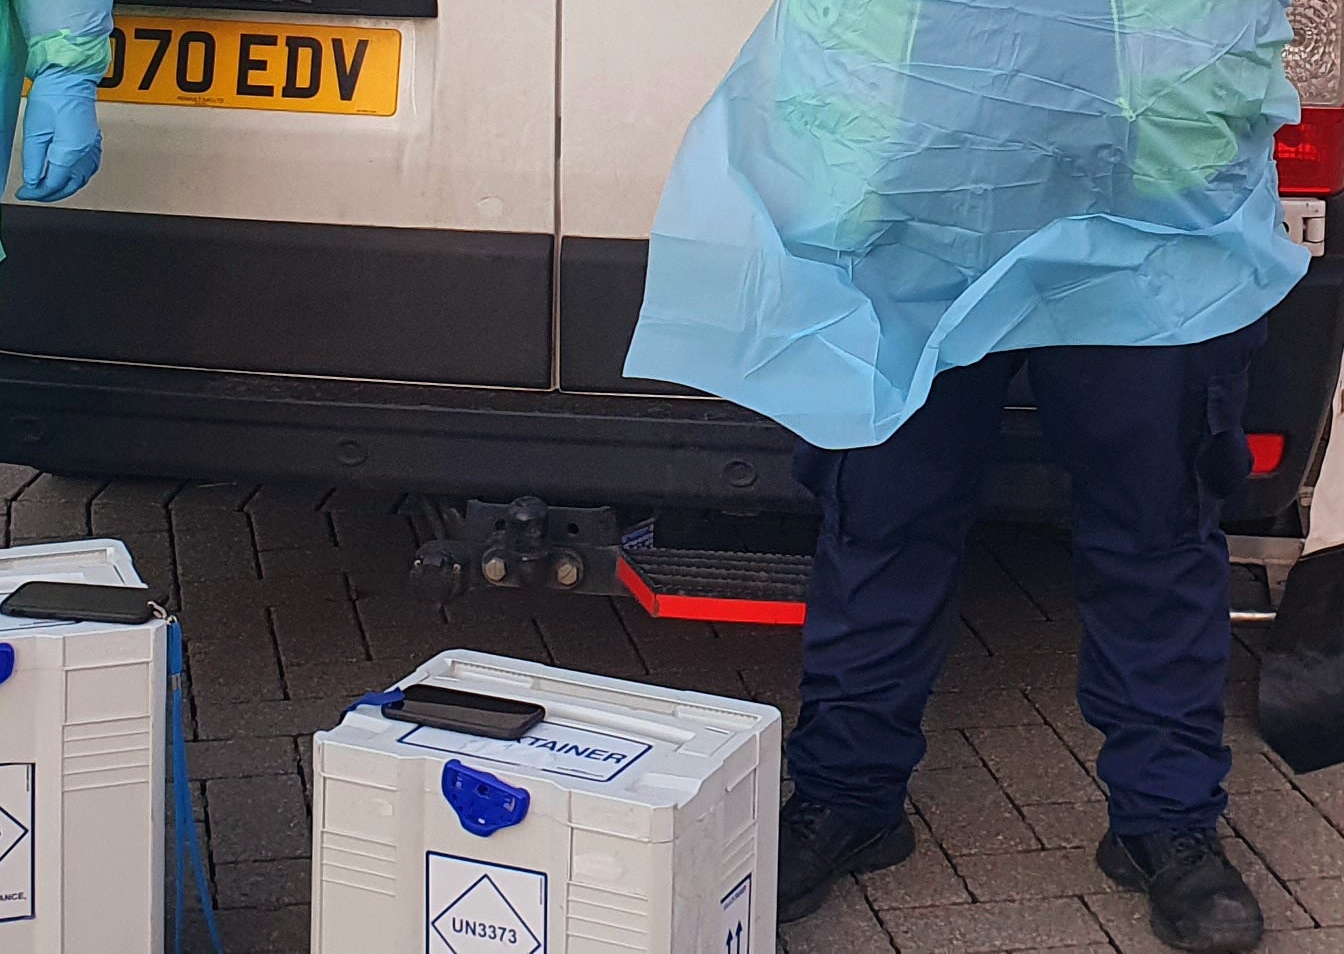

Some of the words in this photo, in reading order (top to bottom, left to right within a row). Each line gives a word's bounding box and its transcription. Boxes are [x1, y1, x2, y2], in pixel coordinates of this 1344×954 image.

[236, 33, 370, 101] EDV
[517, 736, 628, 764] TAINER
[452, 917, 517, 944] UN3373
